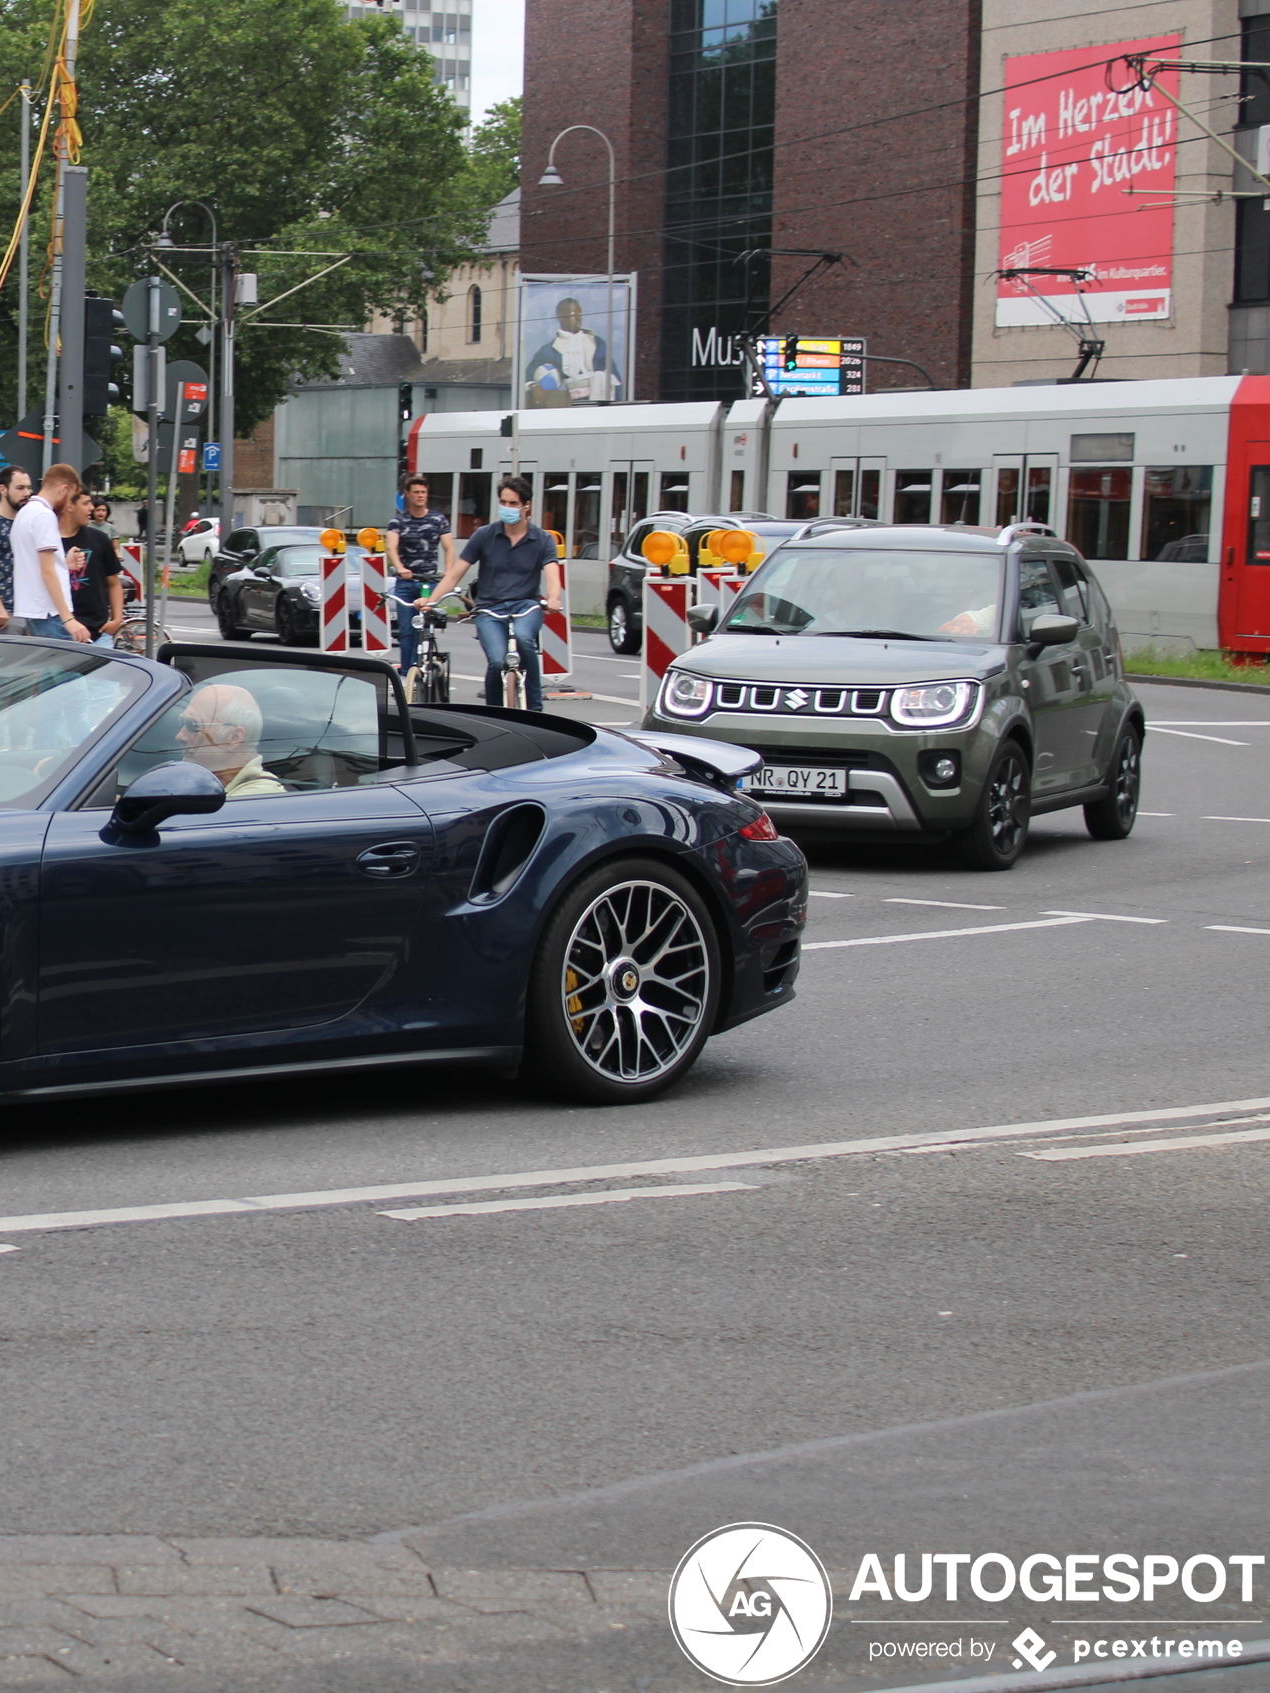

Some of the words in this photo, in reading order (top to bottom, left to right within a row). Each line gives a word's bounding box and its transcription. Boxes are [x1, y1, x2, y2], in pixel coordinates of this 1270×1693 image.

[1006, 107, 1046, 156] Im
[1059, 79, 1154, 140] Herzen
[1028, 152, 1078, 207] der
[1090, 109, 1172, 194] Stadt!
[751, 768, 774, 786] NR
[788, 770, 811, 788] QY
[817, 771, 838, 790] 21
